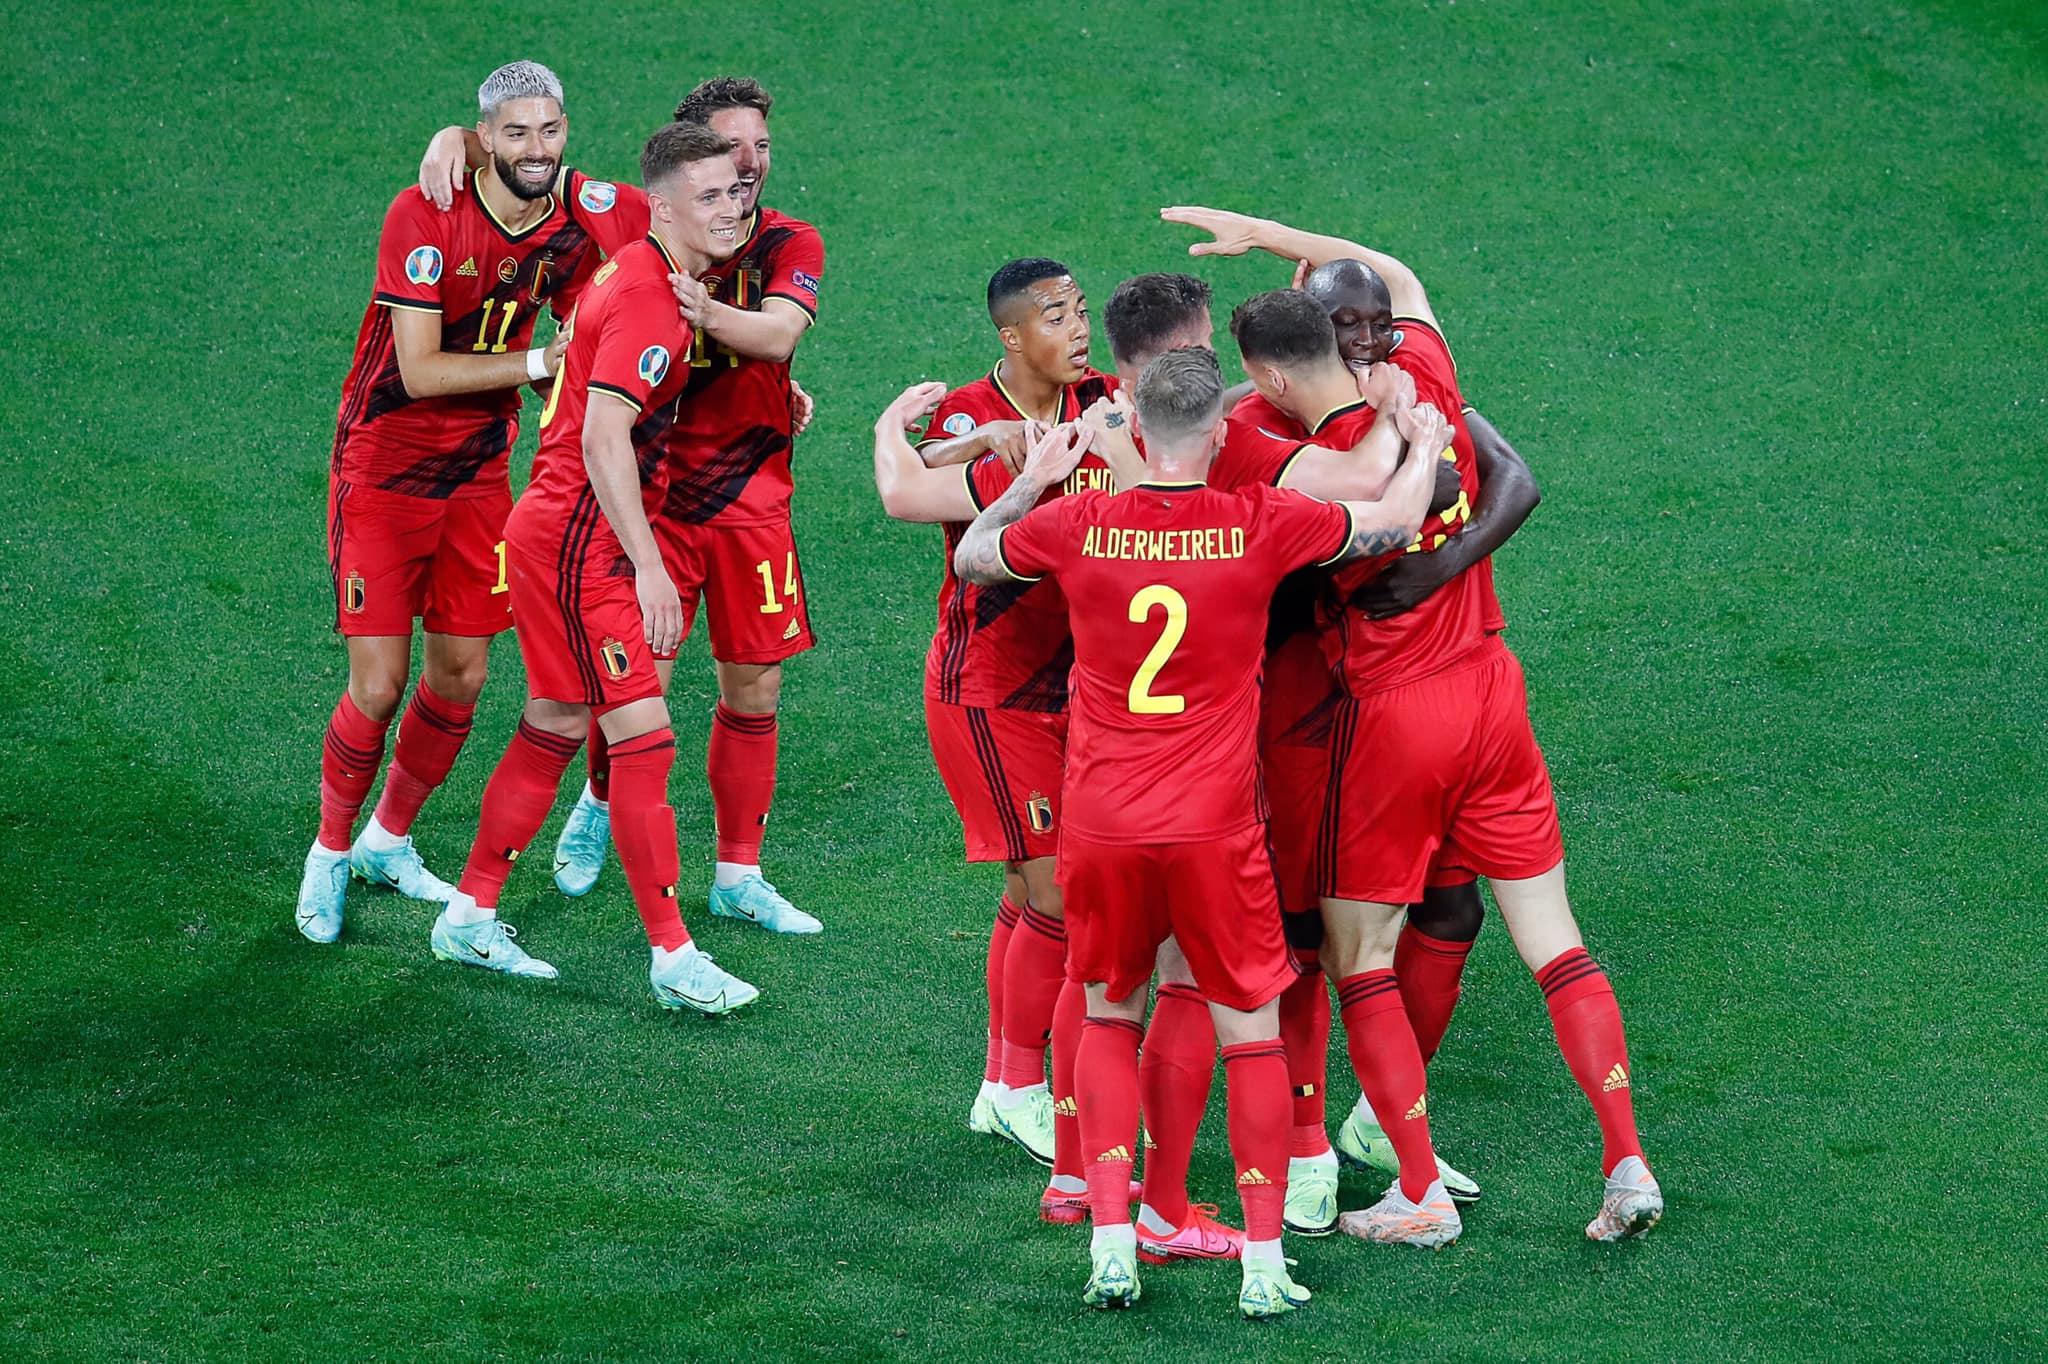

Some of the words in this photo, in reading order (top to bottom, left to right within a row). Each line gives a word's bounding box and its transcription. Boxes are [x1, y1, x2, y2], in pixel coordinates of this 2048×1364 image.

[804, 278, 818, 291] RES
[472, 298, 519, 353] 11
[491, 541, 509, 595] 1
[1081, 526, 1245, 561] ALDERWEIRELD
[756, 551, 798, 614] 14
[1128, 584, 1188, 714] 2
[1097, 1154, 1134, 1163] adidas
